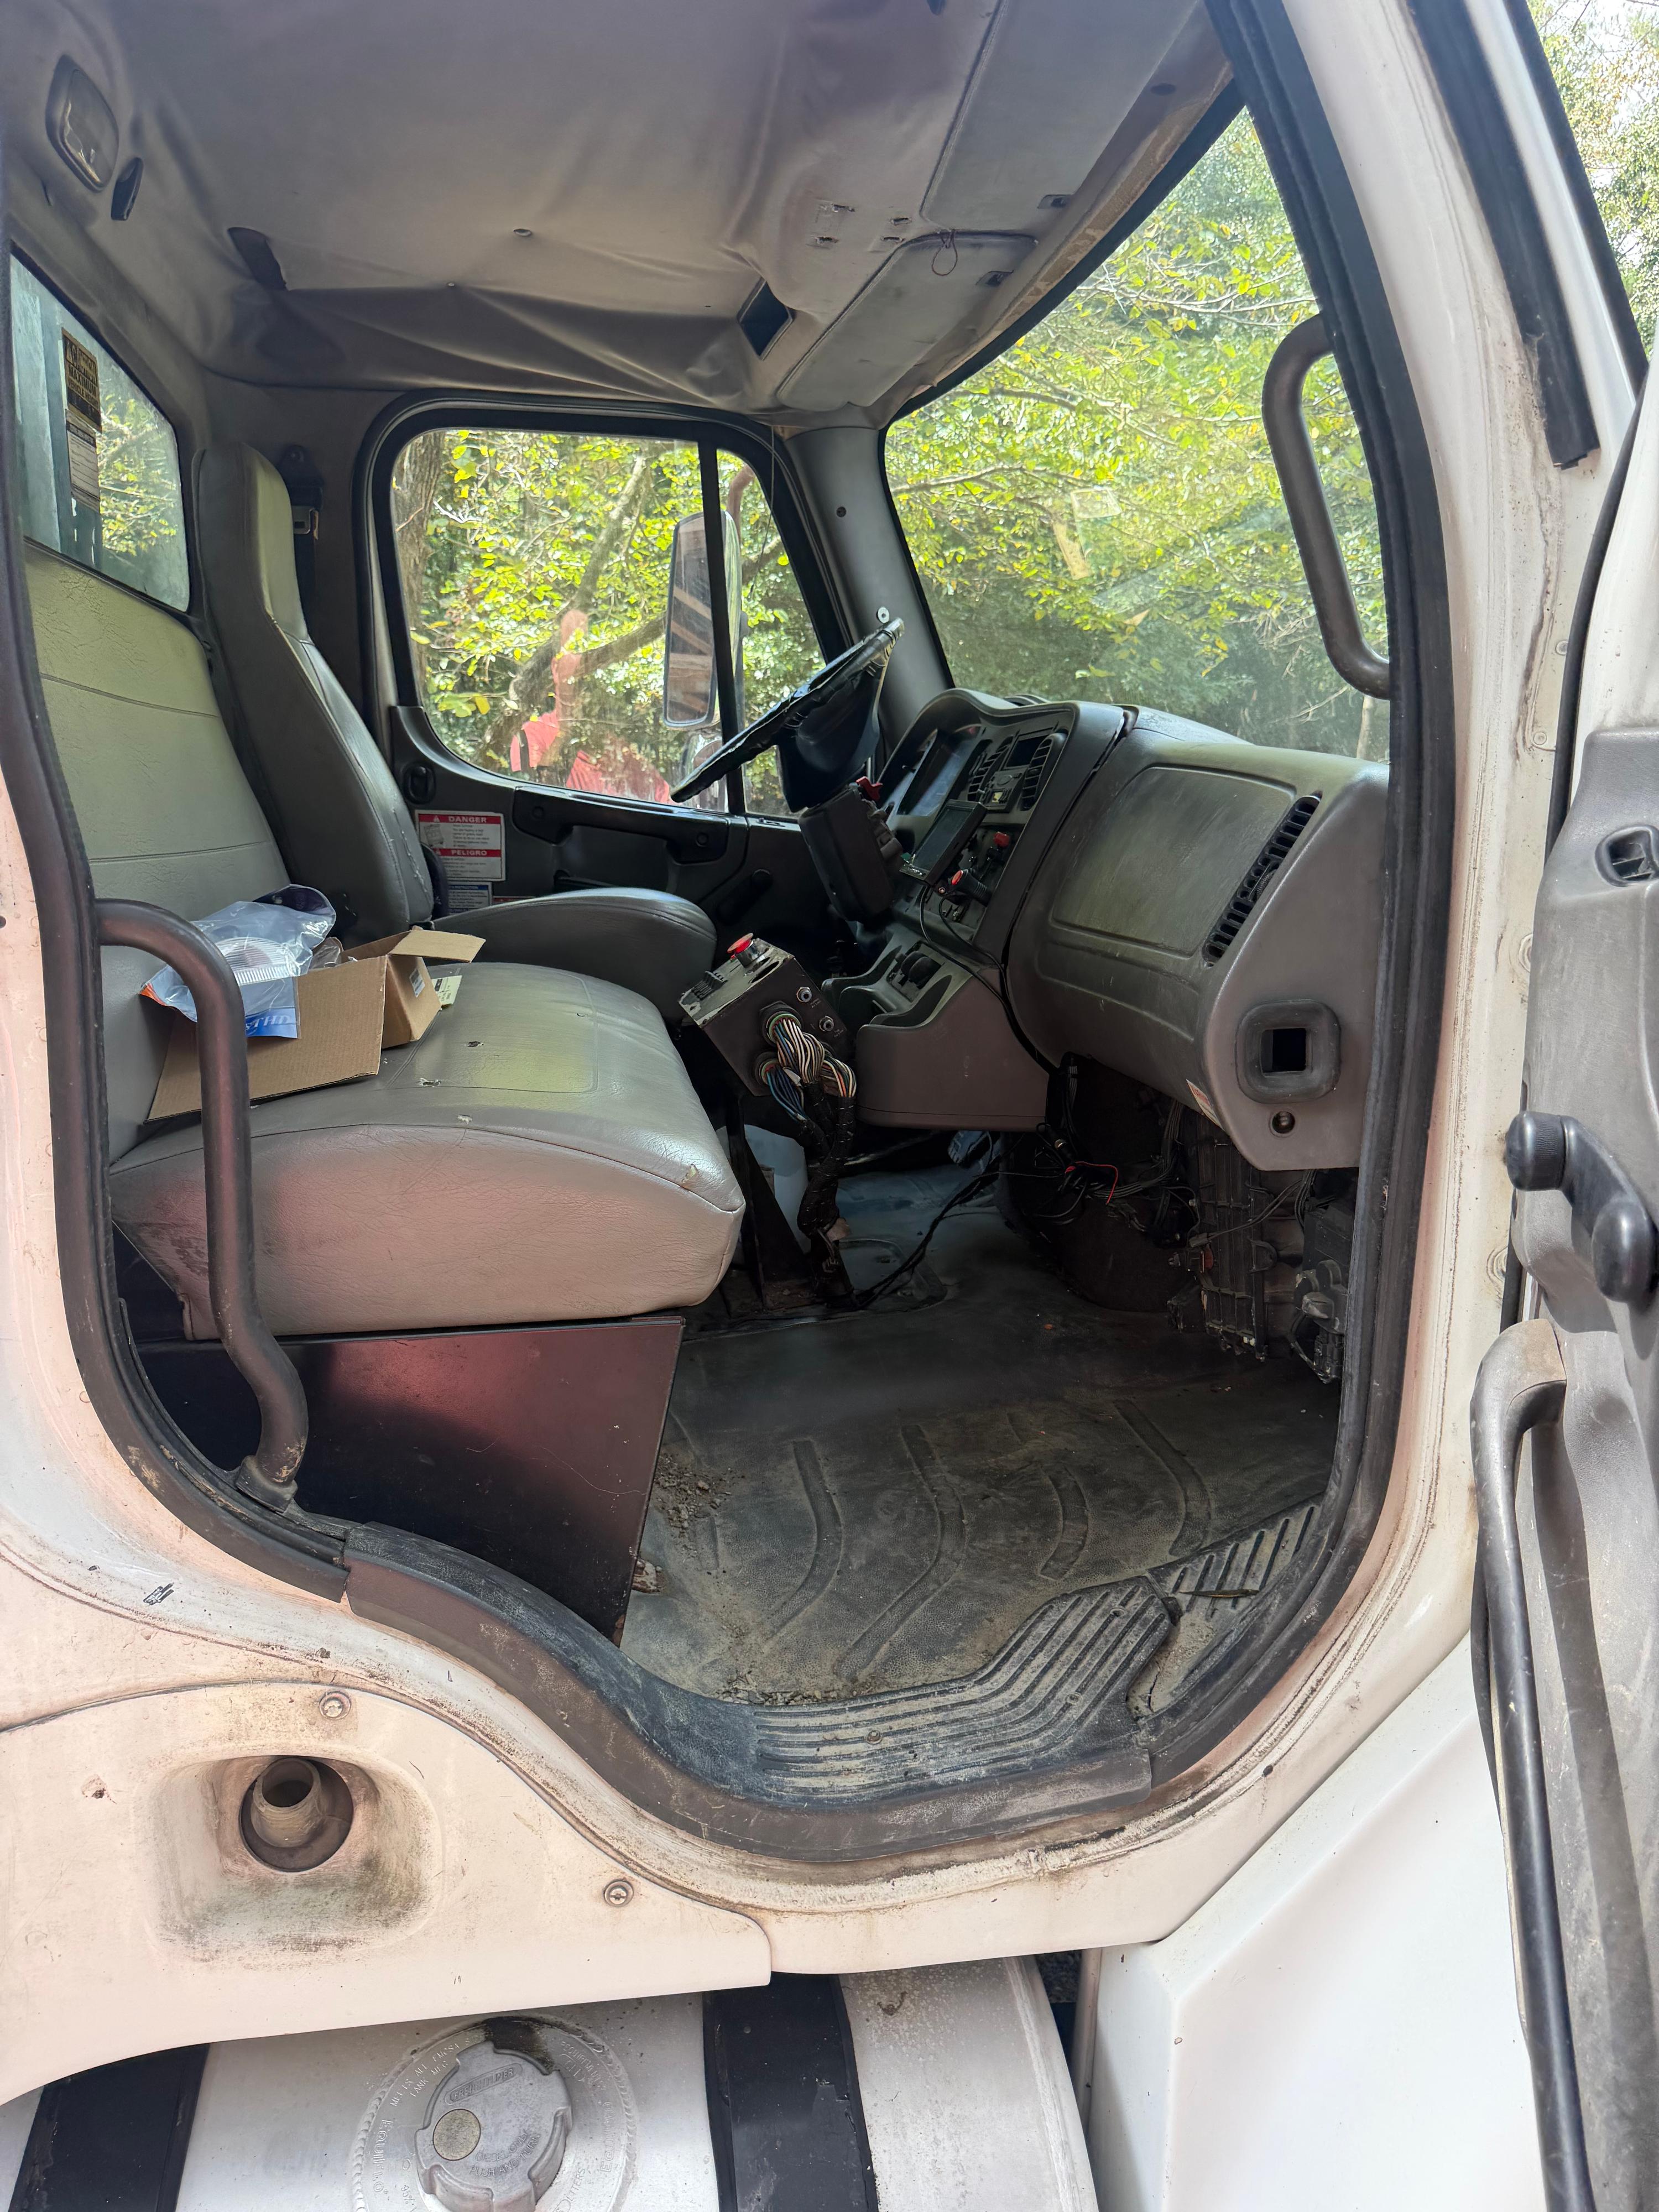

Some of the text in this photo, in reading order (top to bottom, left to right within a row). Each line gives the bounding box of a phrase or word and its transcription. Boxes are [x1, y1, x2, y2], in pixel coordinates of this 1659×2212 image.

[410, 2079, 429, 2097] TANK
[453, 2068, 514, 2100] FREIGHTLINER
[469, 2133, 541, 2177] PUSH AND TURN
[474, 2128, 528, 2163] DIESEL ONLY
[566, 2168, 586, 2201] LITERS
